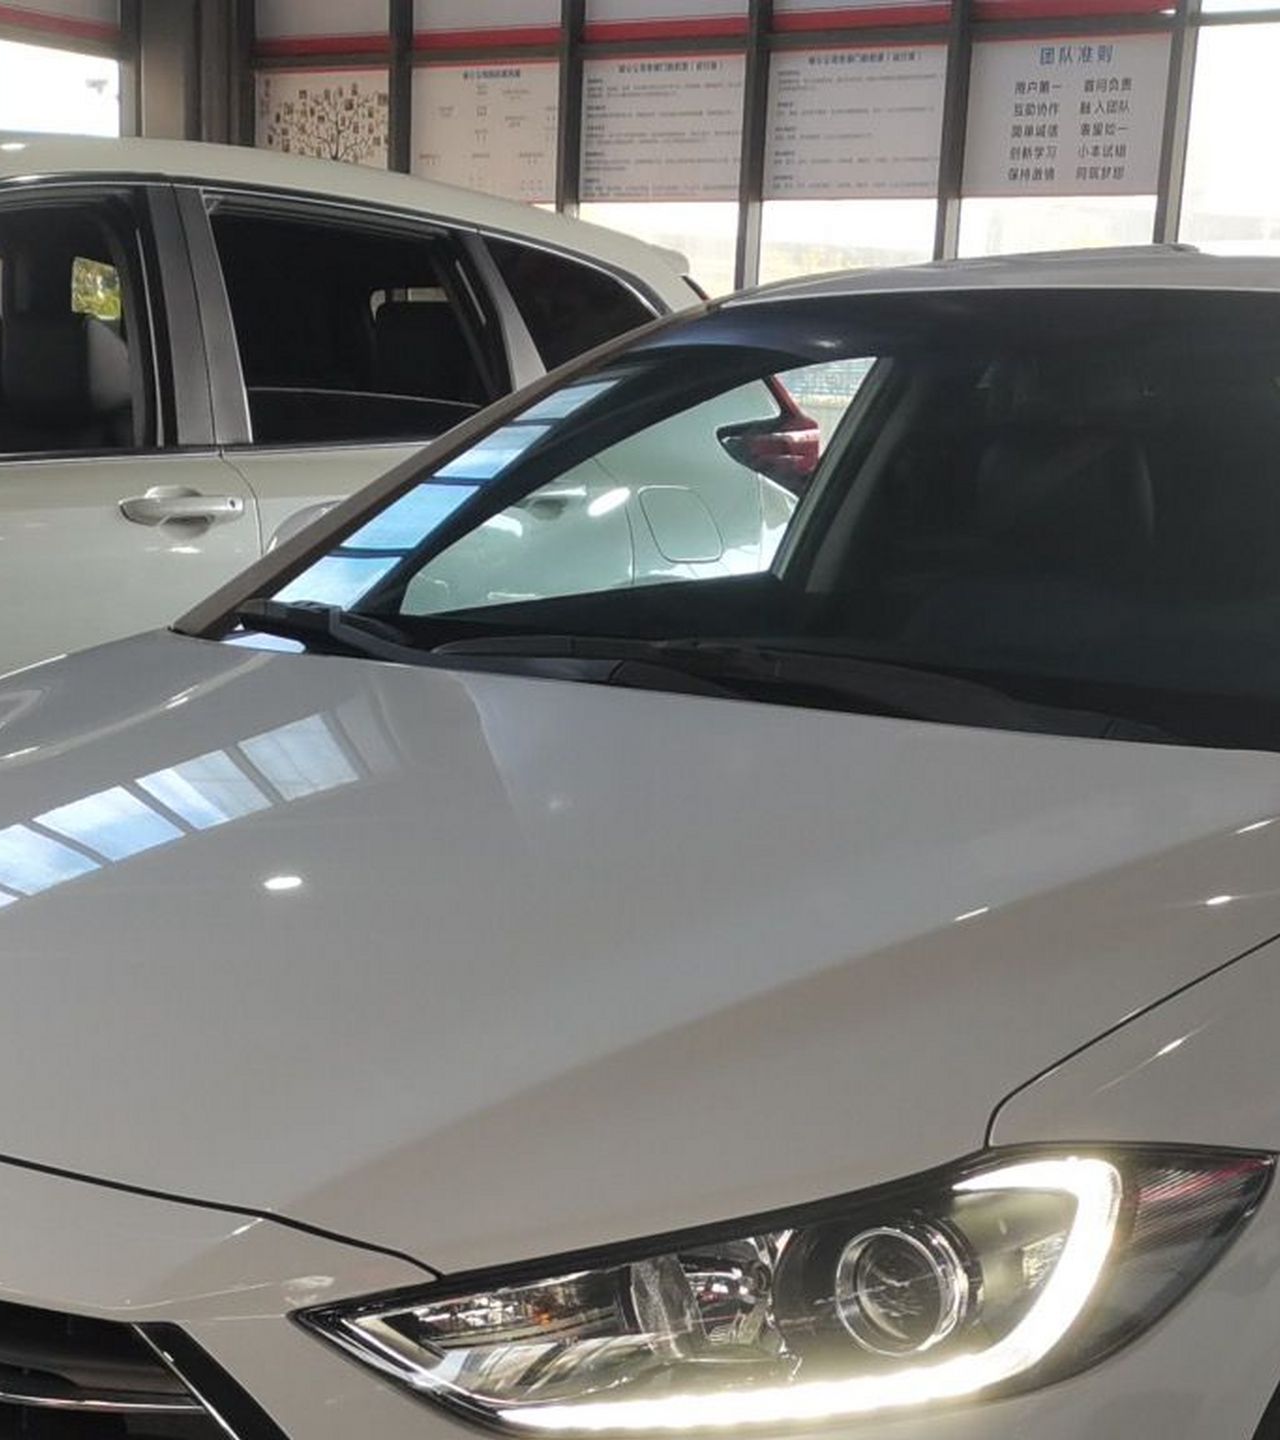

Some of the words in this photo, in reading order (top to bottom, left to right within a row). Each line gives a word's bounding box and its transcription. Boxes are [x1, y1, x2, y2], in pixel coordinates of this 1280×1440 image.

[1040, 45, 1113, 65] 团队准则
[1014, 81, 1062, 95] 用户第一
[1014, 102, 1059, 117] 互助协作
[1080, 100, 1130, 115] 融入团队
[1009, 146, 1057, 160] 创新学习
[1007, 166, 1055, 181] 保持激情
